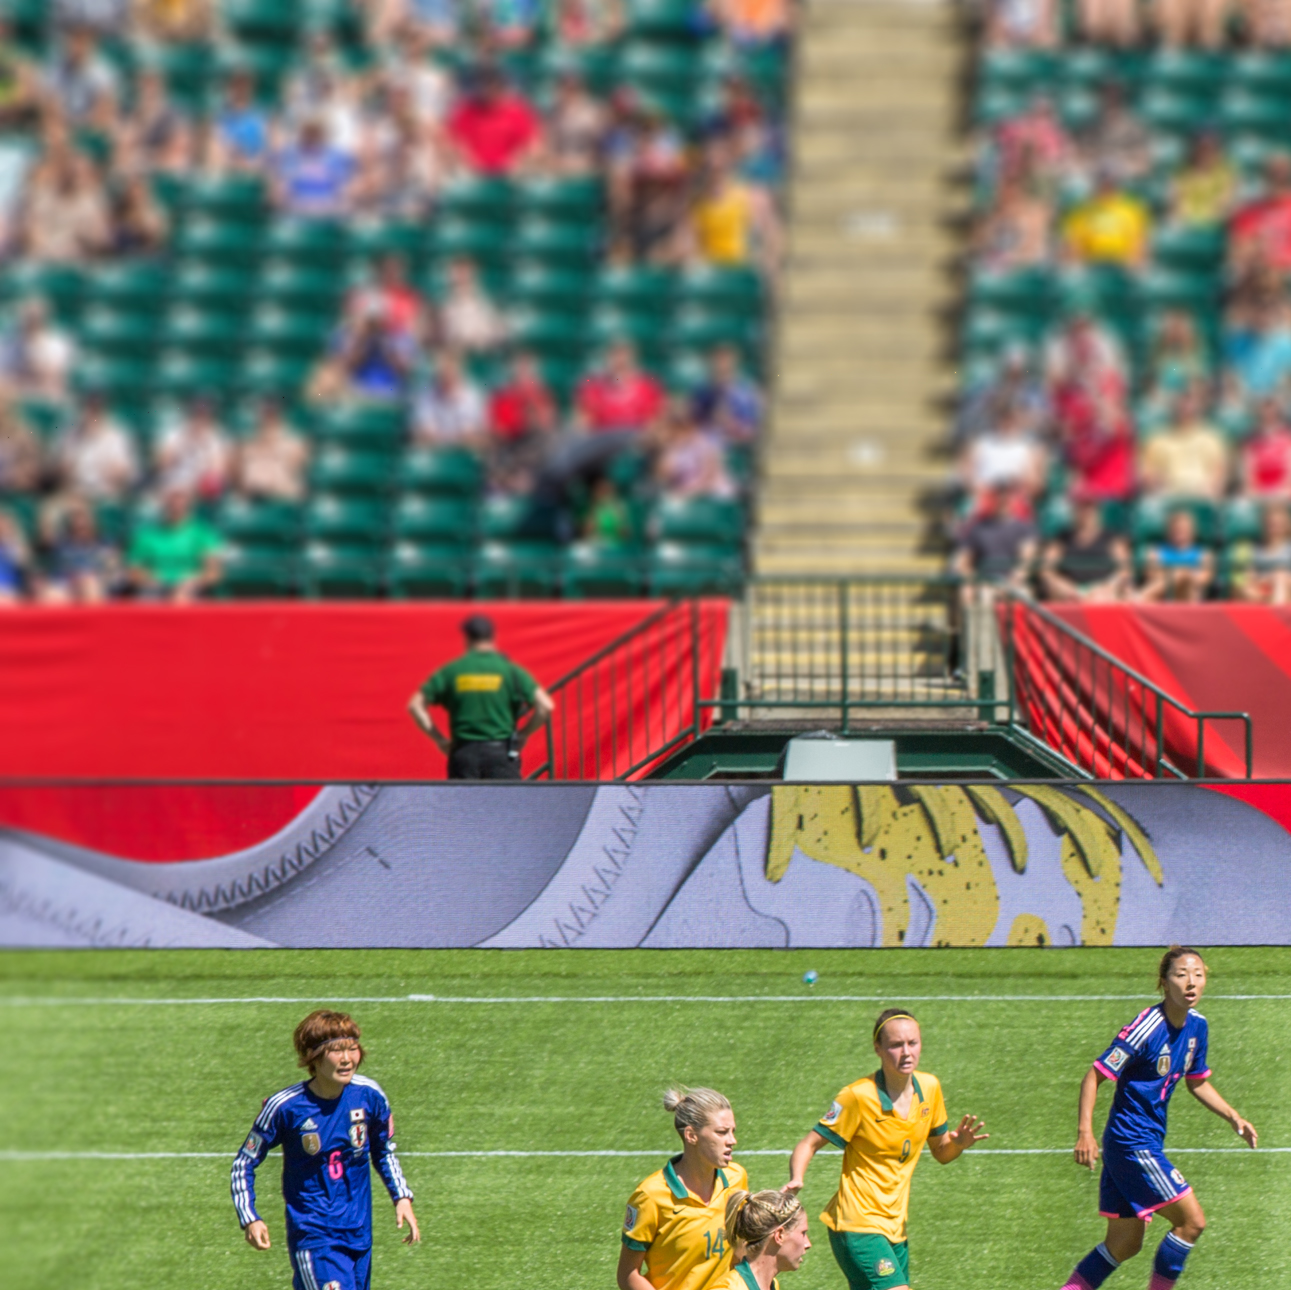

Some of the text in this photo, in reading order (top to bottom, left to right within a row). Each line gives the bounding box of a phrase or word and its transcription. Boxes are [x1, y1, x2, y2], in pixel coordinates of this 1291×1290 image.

[328, 1151, 344, 1181] 6
[898, 1139, 911, 1164] 9
[703, 1228, 725, 1260] 14
